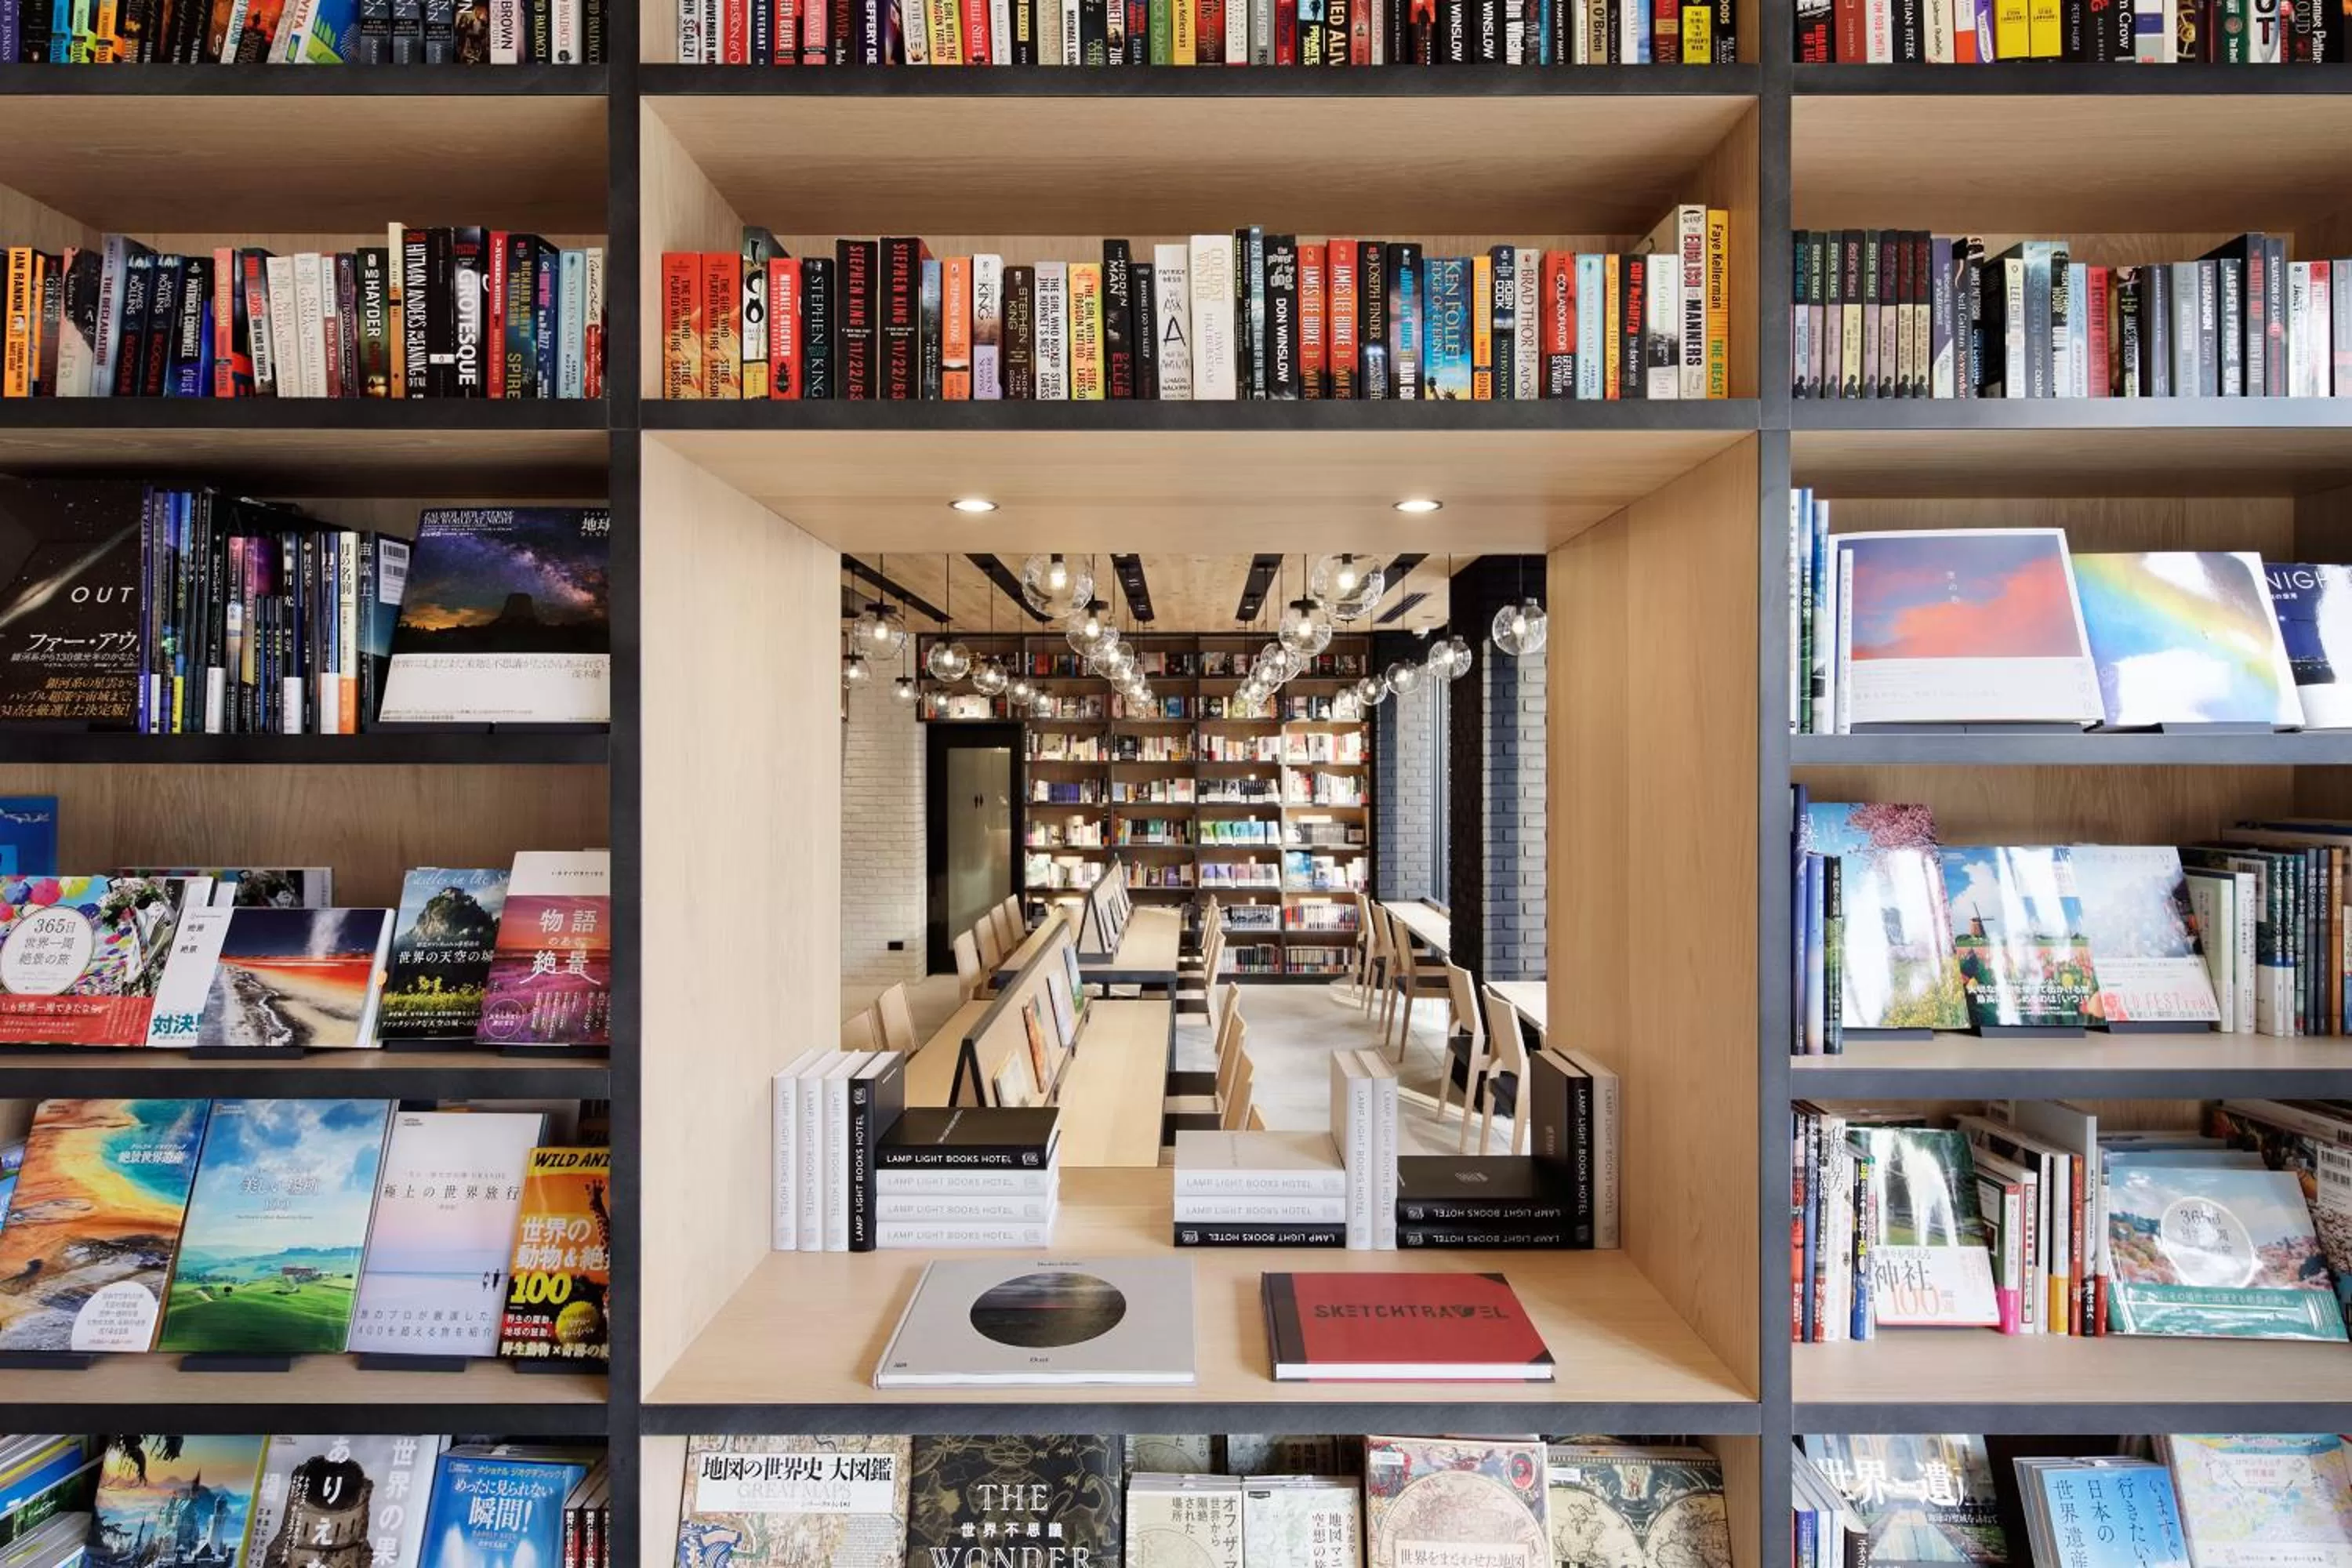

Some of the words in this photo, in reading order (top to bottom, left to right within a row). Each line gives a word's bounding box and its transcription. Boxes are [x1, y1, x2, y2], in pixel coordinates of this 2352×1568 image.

[502, 2, 514, 49] BROWN
[945, 3, 956, 20] GIRL
[3, 26, 12, 60] JENKINS
[536, 14, 546, 57] BALDACCI
[683, 18, 695, 58] SCALZI
[779, 20, 793, 49] DEAVER
[936, 28, 947, 57] TATTOO
[946, 24, 956, 43] WITH
[1178, 9, 1188, 49] Kellerman
[1450, 4, 1462, 61] WINSLOW
[1483, 2, 1494, 59] WINSLOW
[1506, 21, 1525, 64] Winslow
[1593, 7, 1605, 52] O'Brien
[1905, 28, 1918, 59] FITZEK
[2119, 13, 2132, 49] Crow
[947, 46, 958, 60] THE
[1711, 223, 1723, 249] Faye
[14, 251, 29, 270] IAN
[405, 243, 425, 285] HITMAN
[849, 245, 866, 294] STEPHEN
[891, 243, 907, 292] STEPHEN
[1629, 261, 1644, 286] CODY
[1684, 234, 1703, 287] ENGLISH
[14, 272, 29, 311] RANKIN
[100, 275, 113, 294] THE
[521, 260, 532, 302] RICHARD
[710, 274, 720, 303] PLAYED
[720, 278, 729, 292] THE
[779, 274, 791, 310] MICHAEL
[1109, 260, 1120, 295] MAN
[1119, 260, 1127, 306] HIDDEN
[1334, 264, 1351, 294] JAMES
[1367, 261, 1381, 299] JOSEPH
[1521, 268, 1534, 298] BRAD
[1711, 253, 1723, 308] Kellerman
[2226, 265, 2239, 311] JASPER
[154, 273, 169, 314] ROLLINS
[164, 279, 175, 308] JAMES
[183, 278, 198, 313] PATRICIA
[365, 280, 379, 336] HAYDER
[405, 289, 425, 328] ANDERS
[509, 272, 520, 327] PATTERSON
[720, 296, 729, 314] GIRL
[978, 282, 990, 320] KING
[1334, 296, 1351, 315] LEE
[1495, 280, 1504, 309] COOK
[1504, 280, 1514, 309] ROBIN
[1957, 292, 1966, 310] Neil
[710, 305, 720, 327] WITH
[809, 275, 823, 344] STEPHEN
[849, 297, 866, 325] KING
[891, 296, 907, 323] KING
[1075, 292, 1085, 326] DRAGON
[1084, 301, 1094, 320] GIRL
[1276, 298, 1289, 324] DON
[1367, 302, 1381, 339] FINDER
[1555, 274, 1567, 350] COLLABORATOR
[100, 296, 113, 366] DECLARATION
[182, 314, 198, 358] CORNWELL
[458, 269, 477, 386] GROTESQUE
[710, 332, 720, 352] FIRE
[720, 318, 729, 338] WHO
[779, 314, 791, 356] CRICHTON
[1085, 323, 1094, 344] WITH
[1334, 318, 1351, 346] BURKE
[1521, 307, 1534, 347] THOR
[1685, 299, 1702, 366] MANNERS
[1957, 312, 1966, 347] Gaiman
[2226, 315, 2239, 361] FFORDE
[1075, 328, 1085, 358] TATTOO
[1085, 347, 1094, 361] THE
[1276, 326, 1289, 382] WINSLOW
[1711, 338, 1724, 359] THE
[180, 368, 196, 394] dust
[507, 353, 521, 398] SPIRE
[709, 360, 720, 398] LARSSON
[720, 360, 729, 384] STIEG
[809, 358, 823, 398] KING
[849, 340, 866, 399] 11/22/63
[891, 339, 907, 399] 11/22/63
[1113, 353, 1123, 395] ELLIS
[1551, 355, 1563, 394] SEYMOUR
[1562, 355, 1572, 387] GERALD
[1711, 361, 1724, 396] BEAST
[71, 587, 134, 603] OUT
[26, 630, 140, 652] ファー・アウ
[34, 918, 76, 933] 365日
[539, 909, 597, 933] 物語
[24, 937, 74, 949] 世界一周
[19, 953, 71, 966] 絶景の旅
[532, 949, 590, 975] 絶景
[1578, 1088, 1588, 1115] LAMP
[855, 1115, 865, 1144] HOTEL
[1578, 1120, 1588, 1145] LIGHT
[535, 1154, 576, 1167] WILD
[855, 1148, 865, 1181] BOOKS
[887, 1155, 912, 1163] LAMP
[915, 1155, 943, 1163] LIGHT
[946, 1155, 979, 1163] BOOKS
[981, 1155, 1012, 1163] HOTEL
[1578, 1149, 1588, 1181] BOOKS
[383, 1184, 521, 1201] 極上の世界旅行
[855, 1185, 865, 1214] LIGHT
[1578, 1185, 1588, 1215] HOTEL
[1433, 1209, 1465, 1218] HOTEL
[1467, 1209, 1501, 1218] BOOKS
[1504, 1209, 1531, 1218] LIGHT
[1534, 1209, 1561, 1218] LAMP
[522, 1218, 591, 1243] 世界の
[855, 1221, 865, 1242] LAMP
[1208, 1233, 1240, 1242] HOTEL
[1243, 1233, 1275, 1242] BOOKS
[1278, 1233, 1305, 1242] LIGHT
[1309, 1233, 1335, 1242] LAMP
[516, 1243, 609, 1272] 動物&絶
[510, 1272, 572, 1305] 100
[1314, 1304, 1508, 1319] SKETCHTRAVEL
[701, 1456, 822, 1482] 地図の世界史
[832, 1456, 892, 1482] 大図鑑
[372, 1440, 417, 1565] 世界の果
[454, 1478, 554, 1498] めったに見られない
[977, 1483, 1049, 1512] THE
[468, 1497, 533, 1533] 瞬間!
[2053, 1479, 2089, 1568] 世界遺産
[2087, 1479, 2115, 1543] 日本の
[2148, 1479, 2178, 1562] いますぐ
[960, 1522, 1062, 1538] 世界不思議
[929, 1546, 1091, 1568] WONDER
